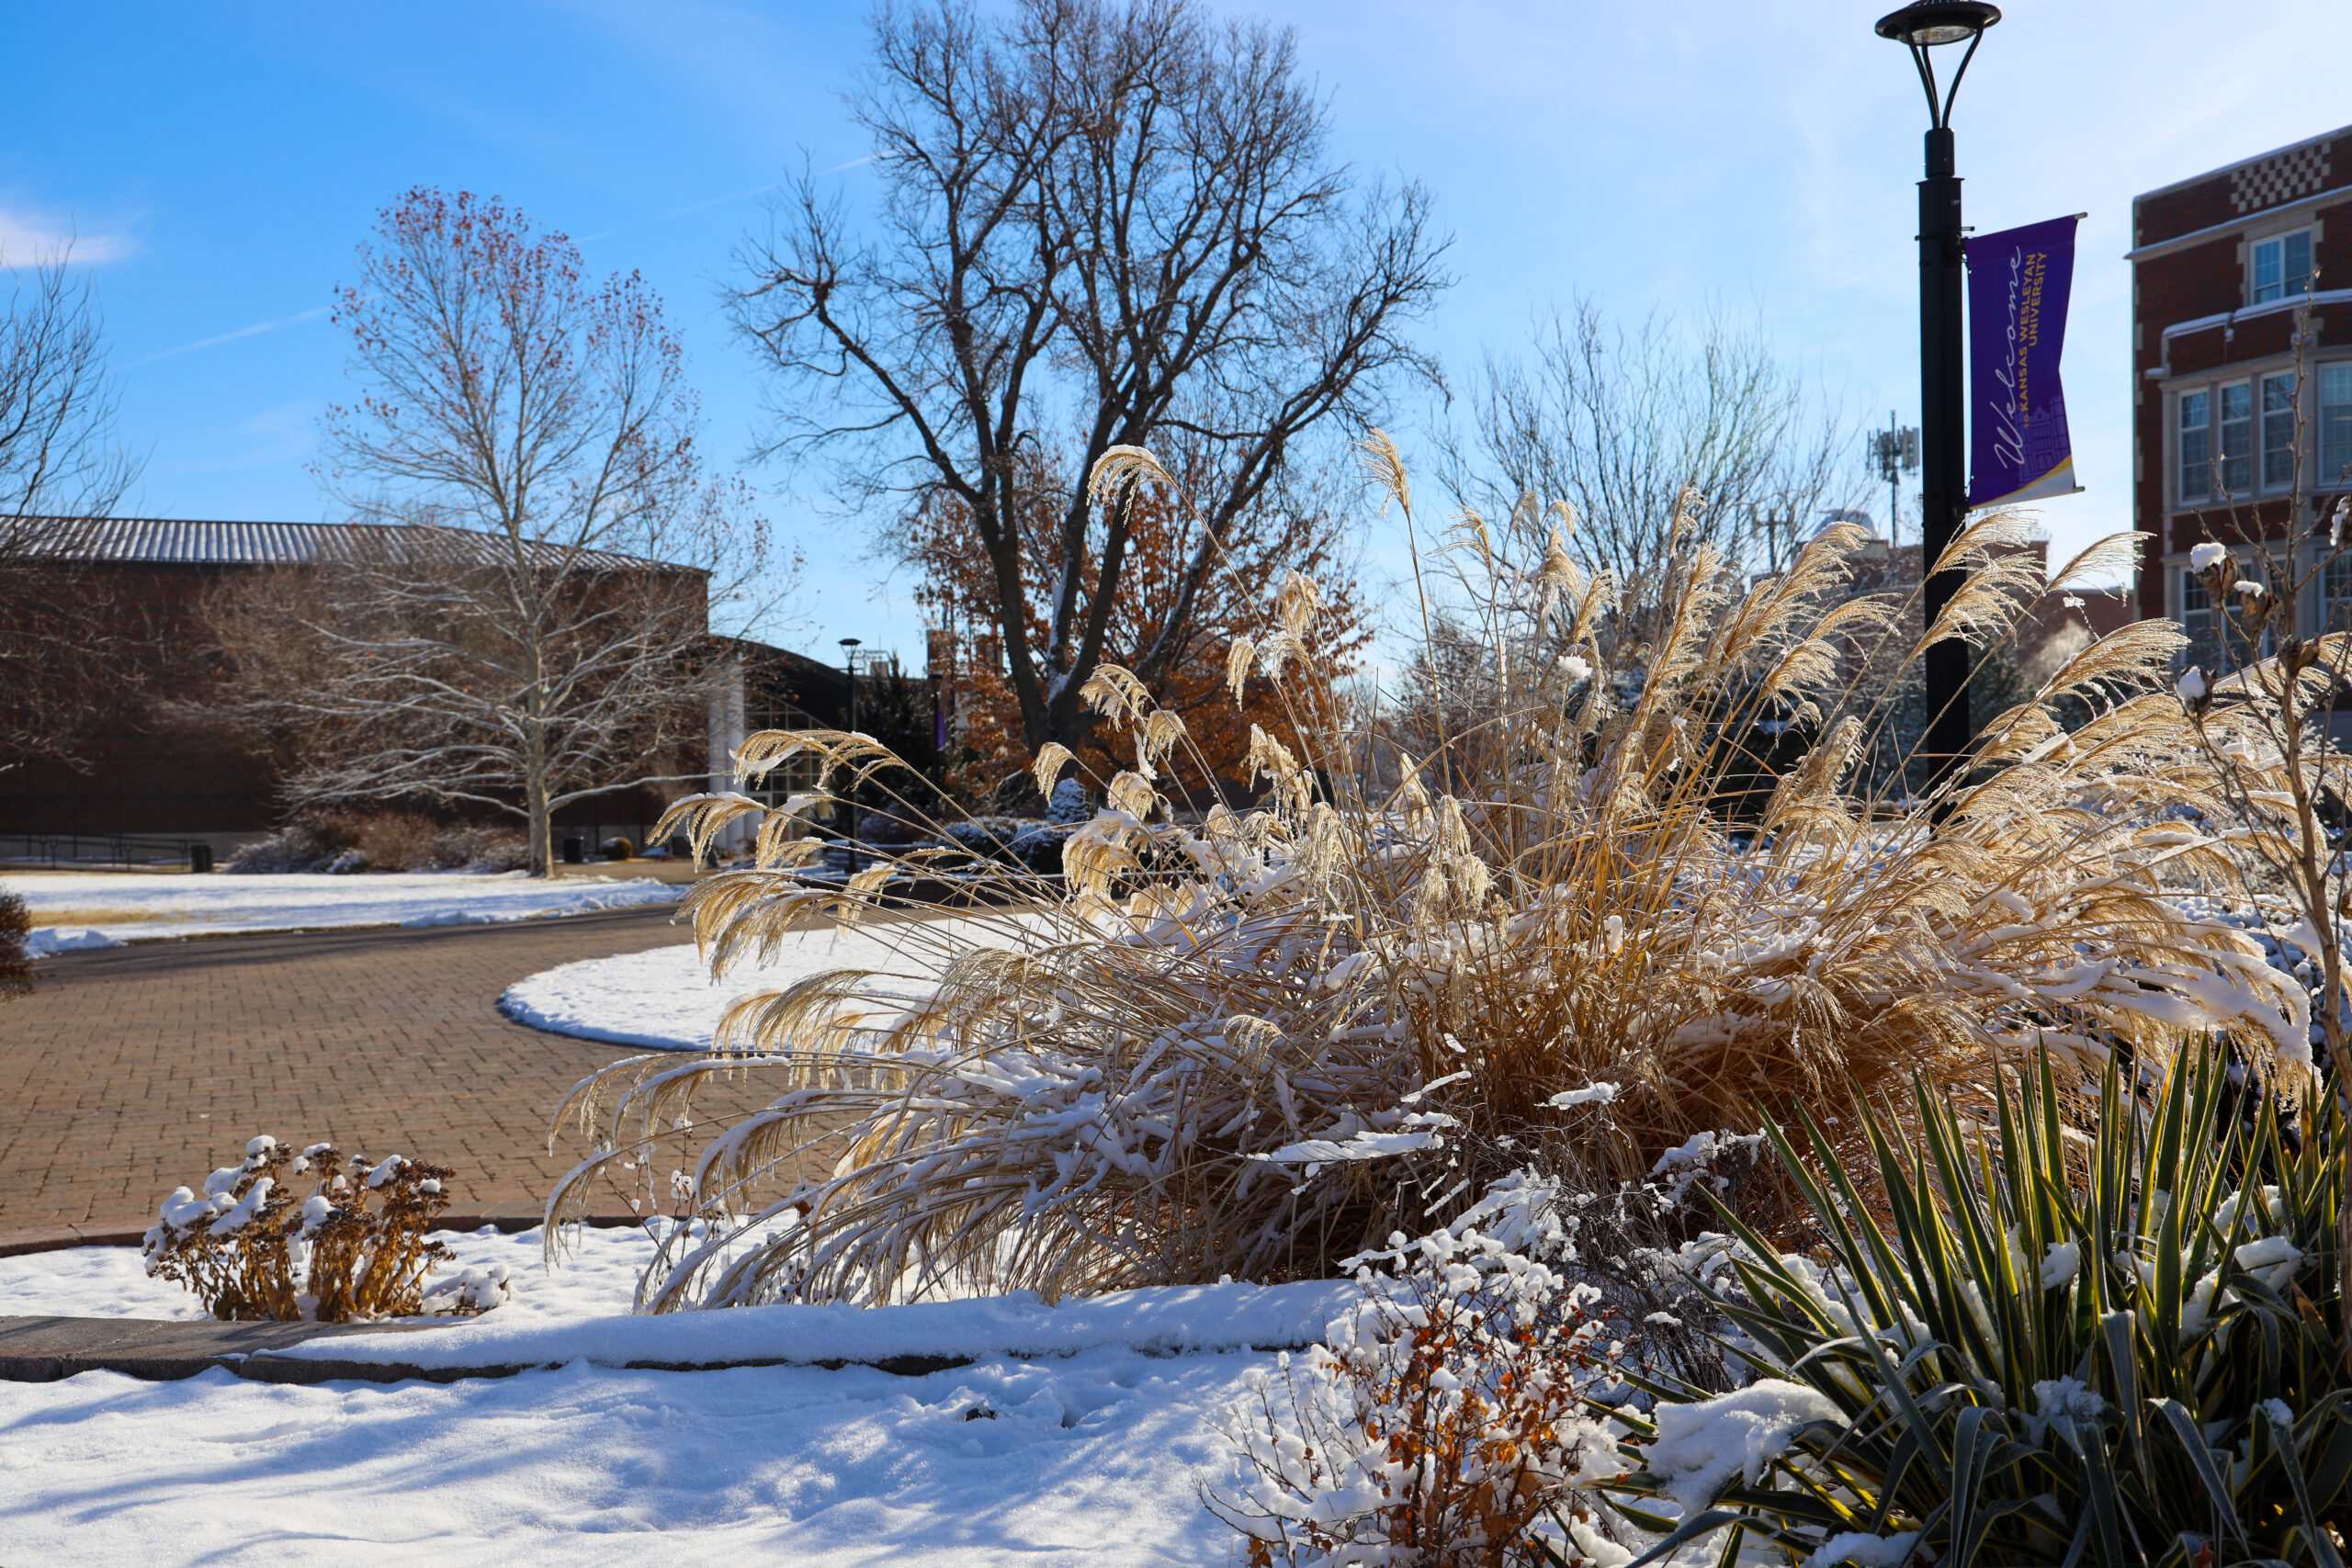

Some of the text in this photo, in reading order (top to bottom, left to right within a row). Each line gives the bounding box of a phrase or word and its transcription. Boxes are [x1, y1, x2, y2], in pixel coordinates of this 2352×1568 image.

[2019, 254, 2036, 342] WESLEYAN
[2029, 252, 2048, 346] UNIVERSITY
[1990, 245, 2025, 468] Welcome
[2018, 346, 2029, 412] KANSAS
